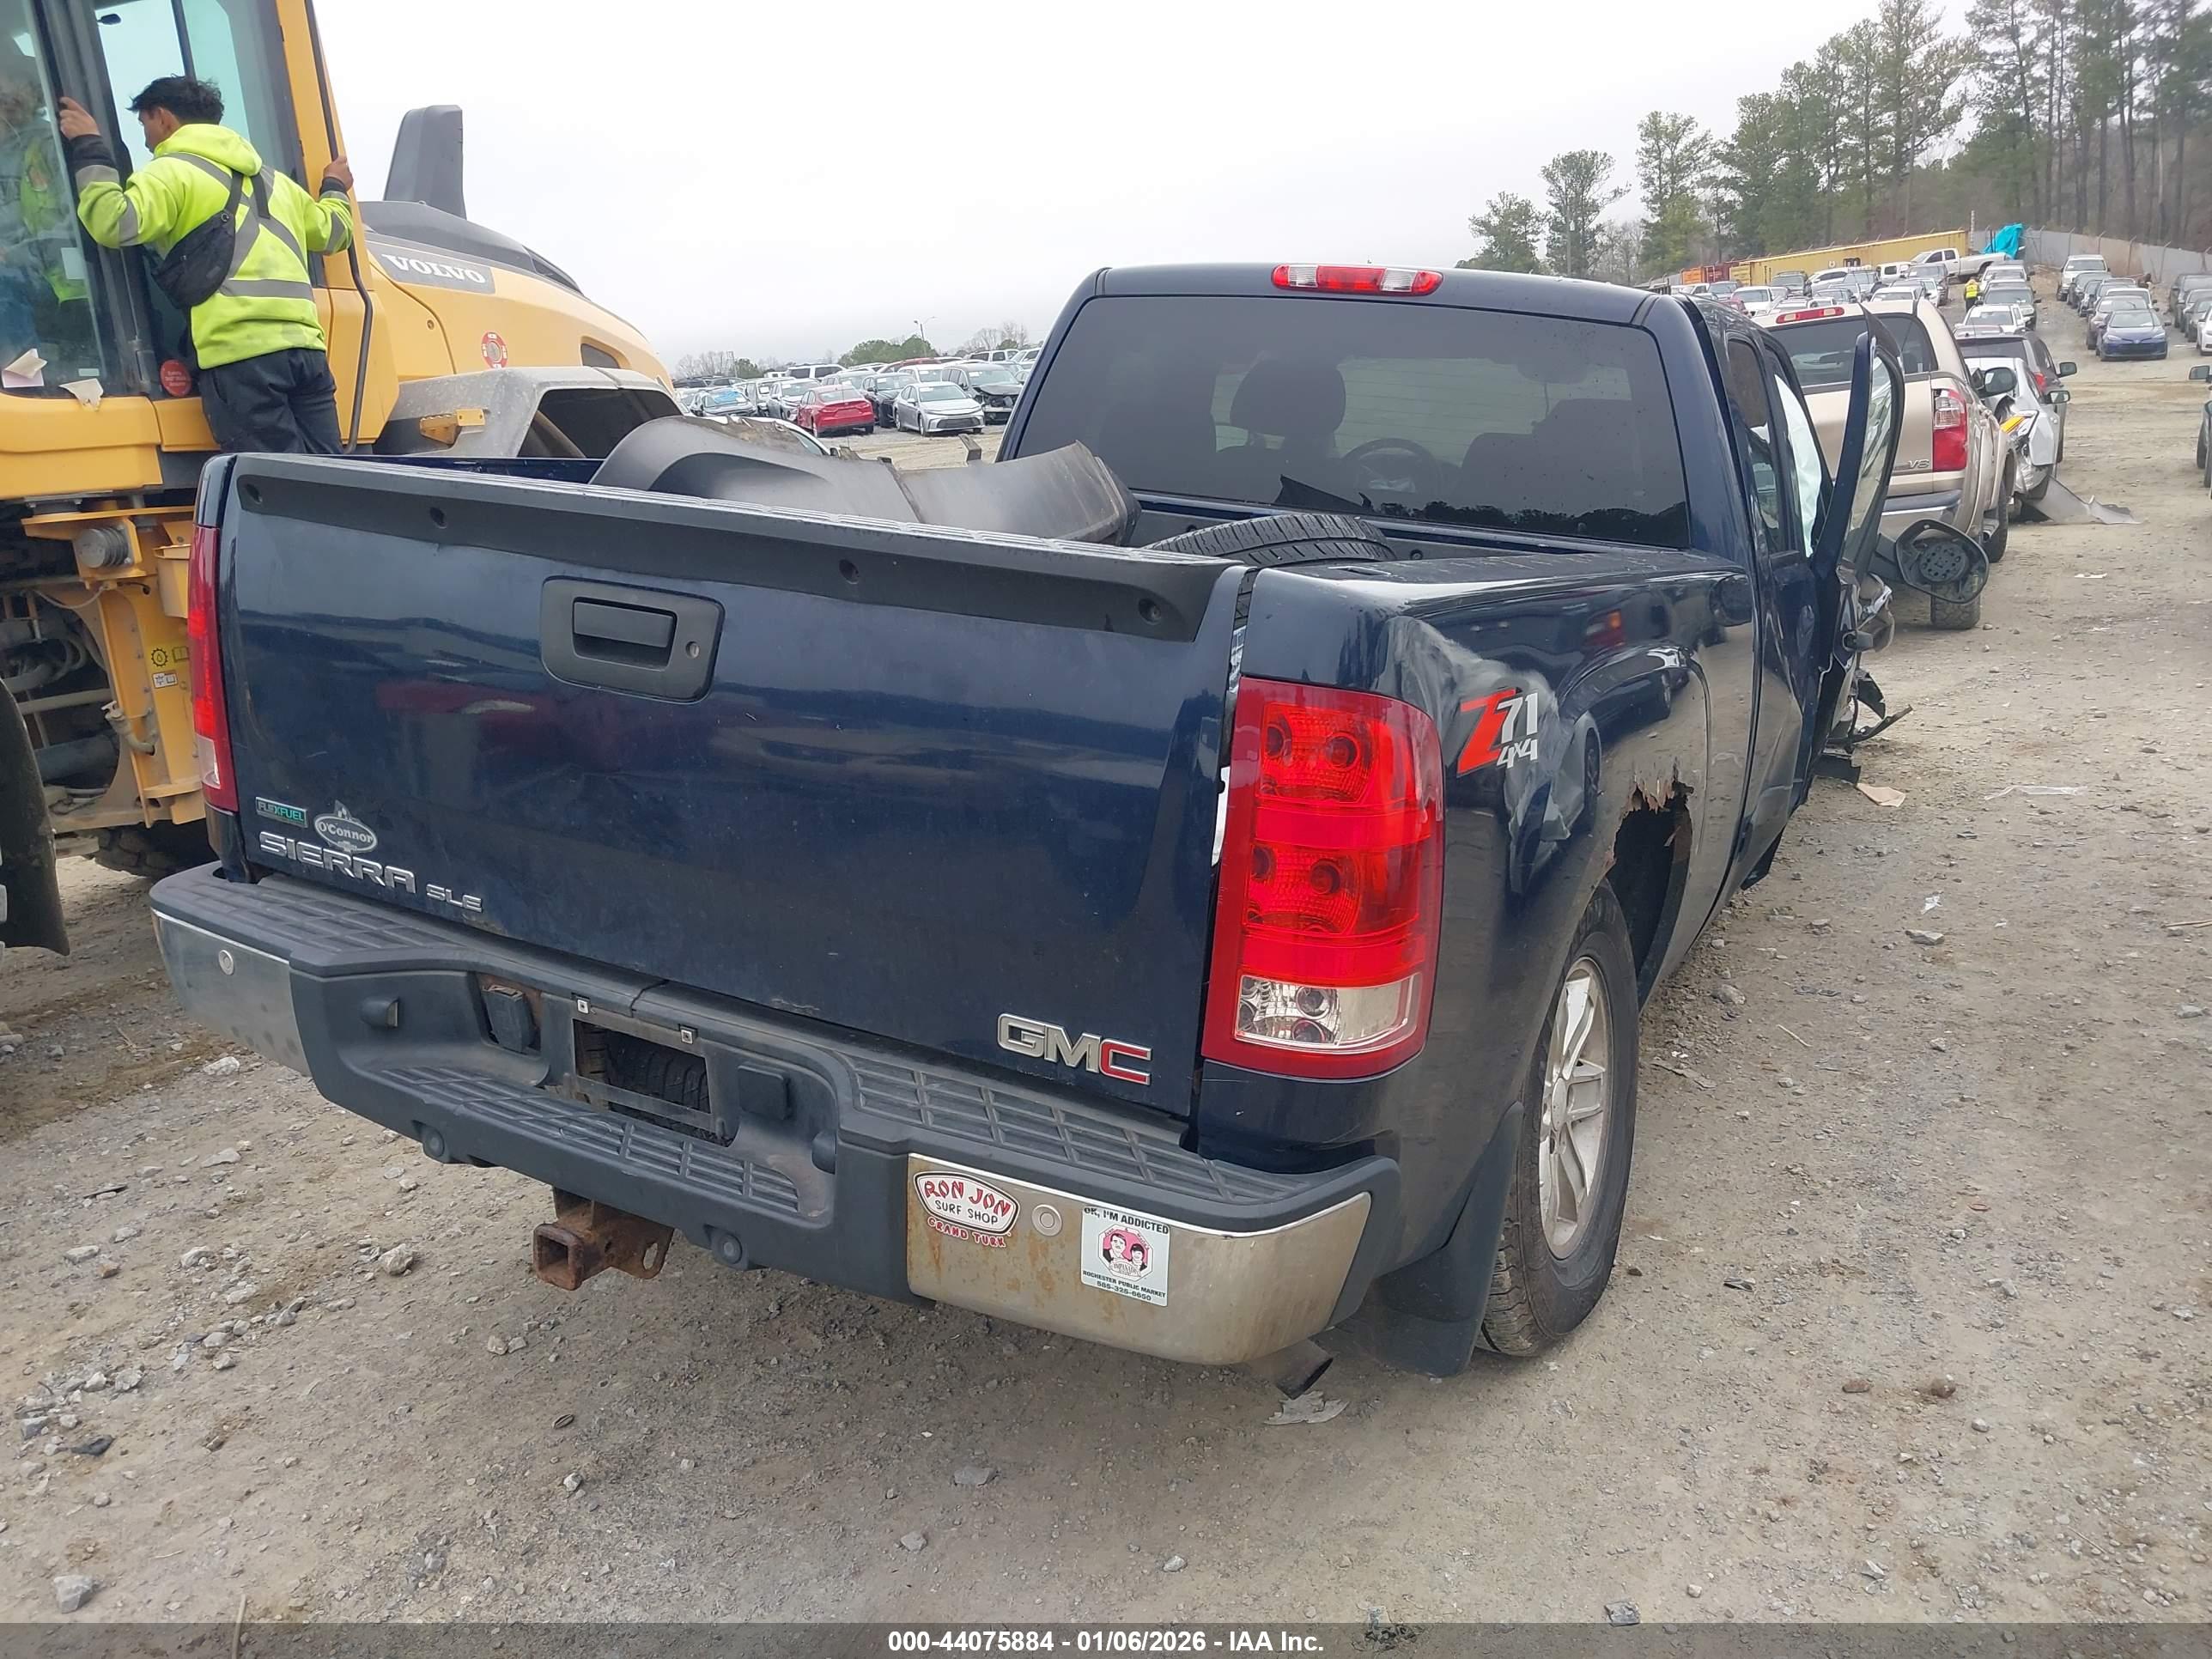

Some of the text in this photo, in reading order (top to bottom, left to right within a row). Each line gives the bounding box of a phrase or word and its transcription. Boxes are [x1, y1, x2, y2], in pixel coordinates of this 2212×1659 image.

[381, 254, 486, 283] VOLVO
[1907, 459, 1930, 469] V8
[1456, 687, 1538, 775] Z71
[258, 798, 305, 822] FLEXFUEL
[319, 820, 374, 844] O'Connor
[259, 831, 416, 894] SIERRA
[426, 884, 482, 913] SLE
[997, 1012, 1152, 1086] GMC
[924, 1180, 1012, 1217] RON JON
[935, 1200, 998, 1224] SURF SHOP
[928, 1217, 1006, 1247] GRAND TURK
[1084, 1207, 1169, 1235] OK, I'M ADDICTED
[1083, 1270, 1116, 1284] ROCHESTER
[1118, 1279, 1139, 1291] PUBLIC
[1141, 1286, 1166, 1297] MARKET
